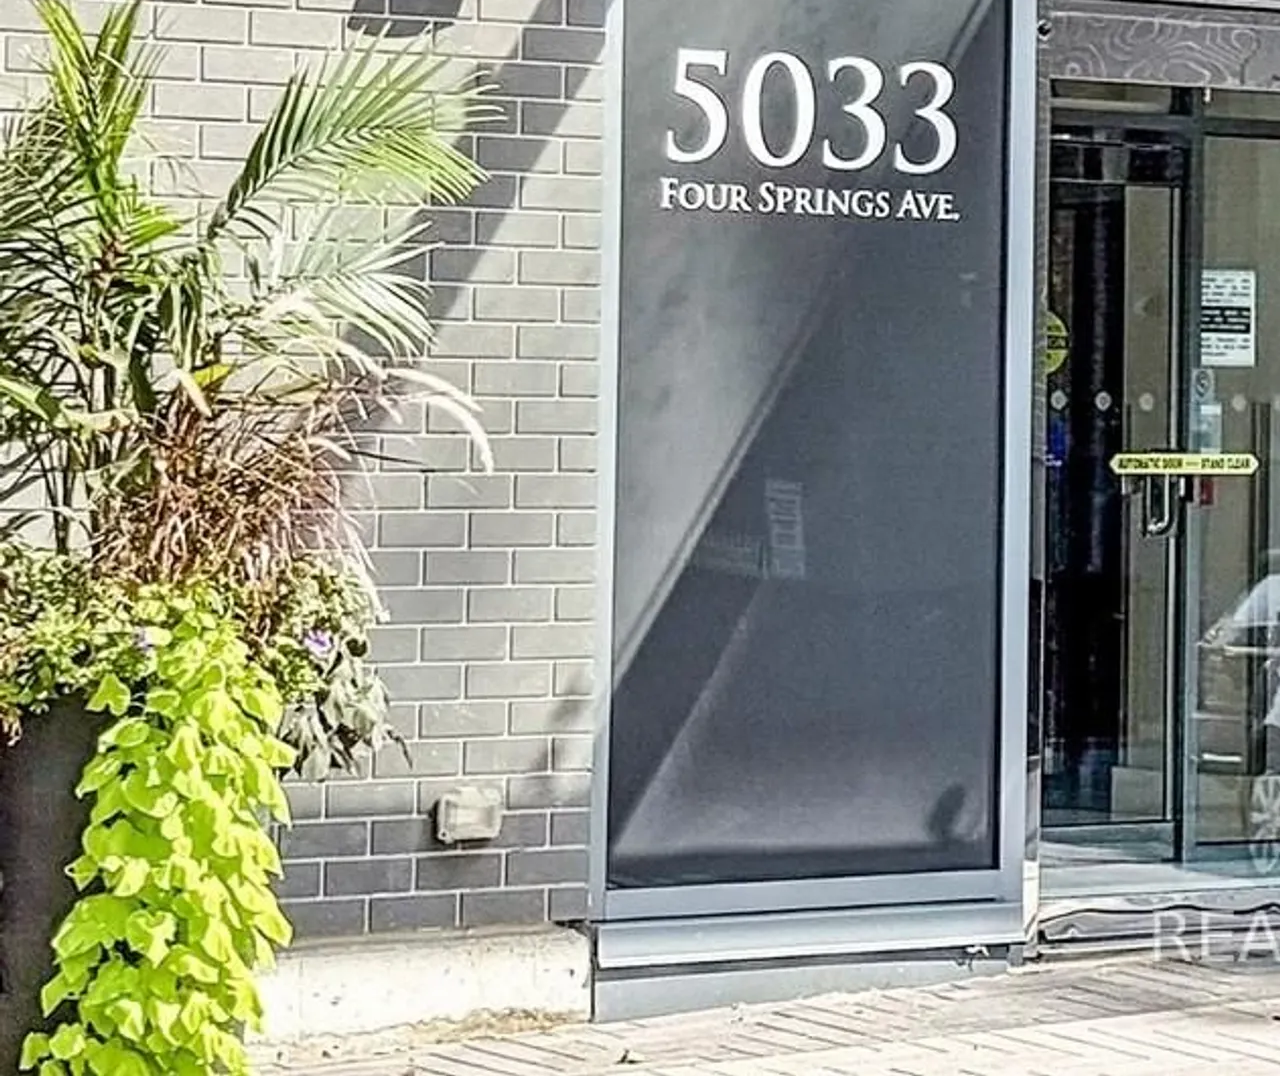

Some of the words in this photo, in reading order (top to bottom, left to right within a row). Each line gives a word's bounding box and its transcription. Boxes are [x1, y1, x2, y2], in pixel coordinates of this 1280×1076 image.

[666, 47, 958, 175] 5033
[660, 178, 754, 212] FOUR
[757, 182, 891, 218] SPRINGS
[895, 192, 960, 221] AVE.
